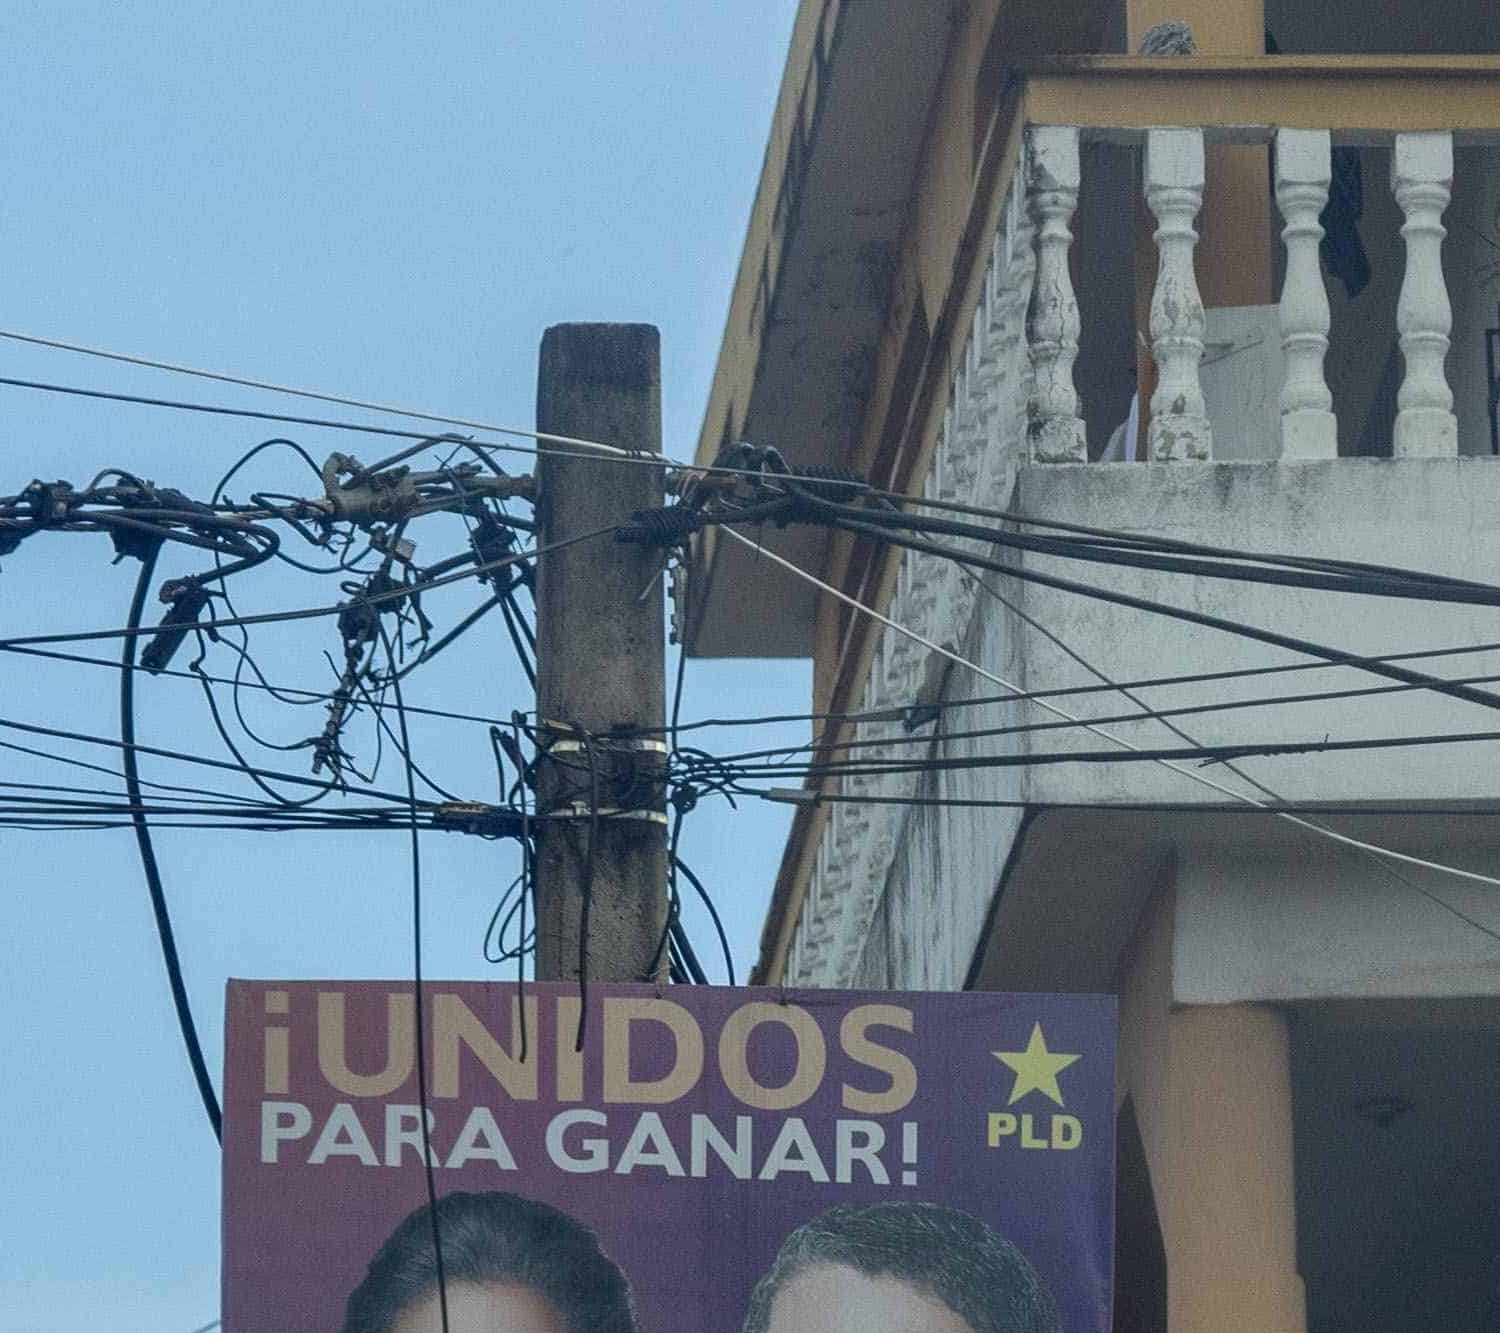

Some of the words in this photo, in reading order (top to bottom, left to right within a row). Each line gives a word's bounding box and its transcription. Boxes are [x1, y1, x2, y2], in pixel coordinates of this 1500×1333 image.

[263, 989, 919, 1115] ¡UNIDOS
[259, 1100, 520, 1171] PARA
[543, 1107, 920, 1186] GANAR!
[987, 1111, 1082, 1150] PLD
